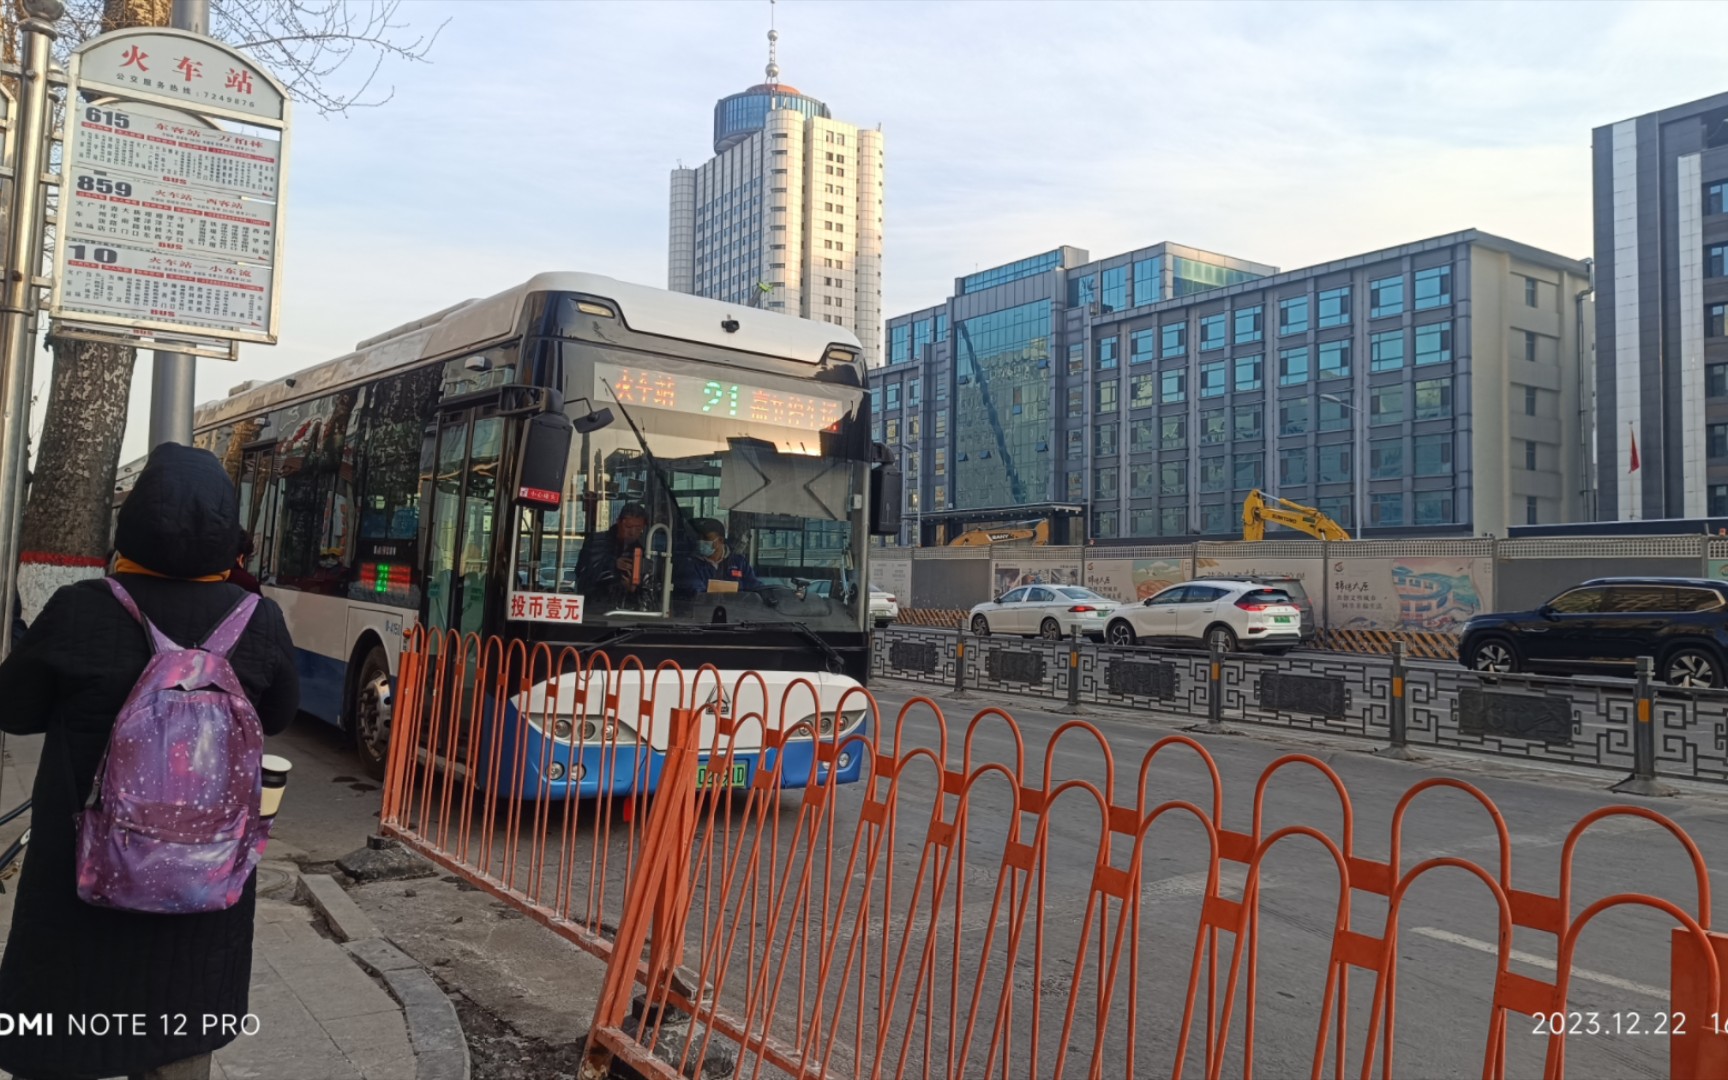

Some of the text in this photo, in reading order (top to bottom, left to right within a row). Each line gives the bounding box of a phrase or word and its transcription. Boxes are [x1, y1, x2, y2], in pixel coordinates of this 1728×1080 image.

[118, 44, 254, 95] 火车站
[85, 106, 130, 129] 615
[77, 175, 132, 198] 859
[162, 176, 187, 185] BUS
[68, 244, 118, 264] 10
[158, 241, 183, 250] BUS
[150, 309, 175, 318] BUS
[702, 380, 738, 416] 21
[511, 594, 580, 621] 投币壹元
